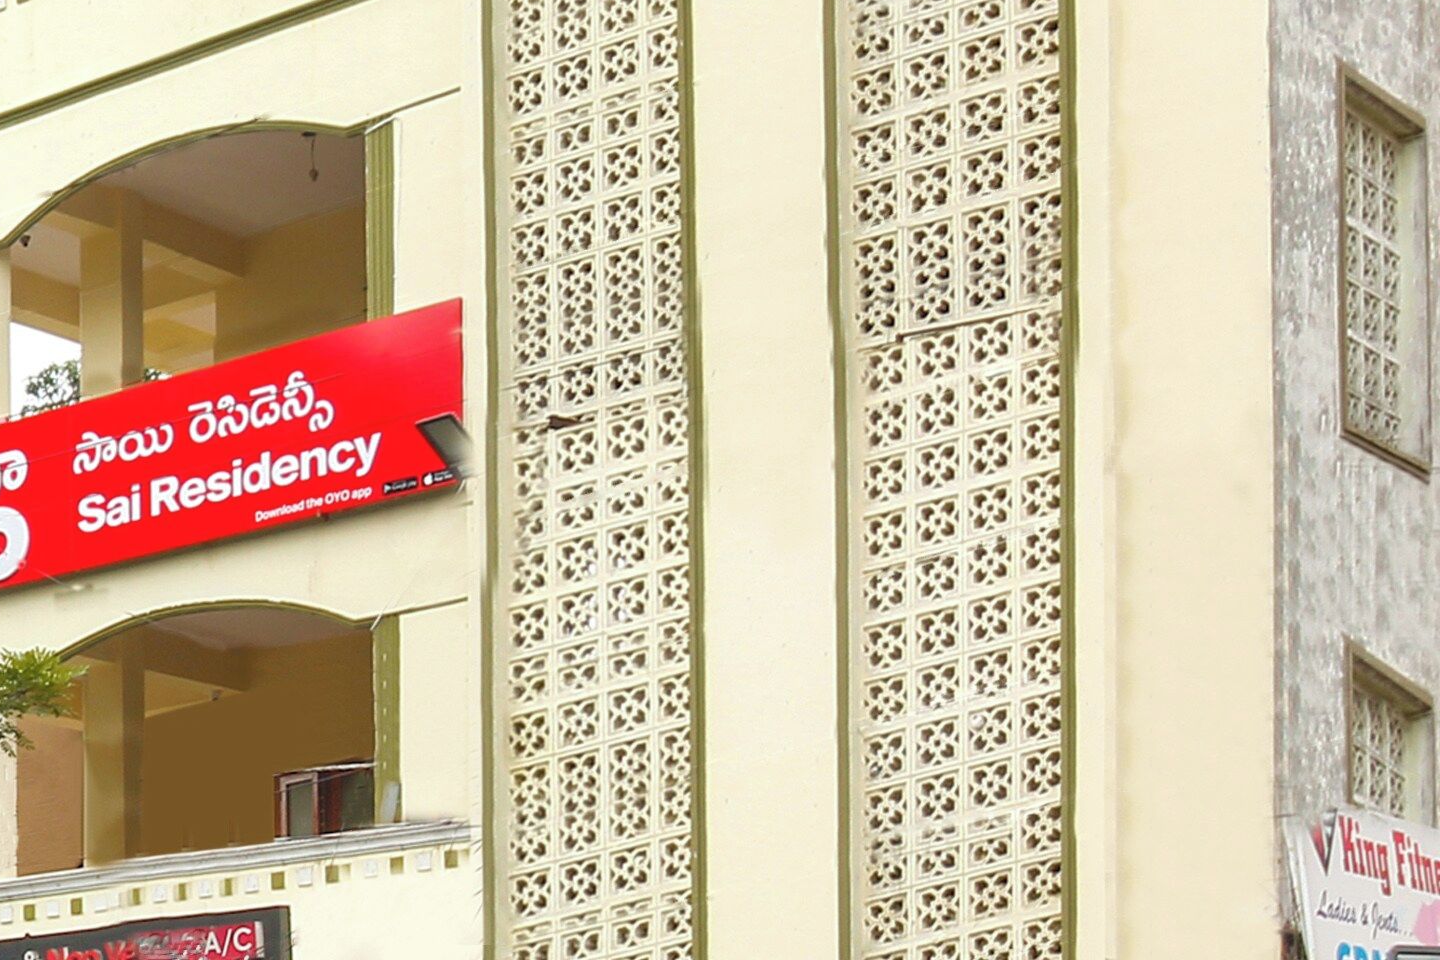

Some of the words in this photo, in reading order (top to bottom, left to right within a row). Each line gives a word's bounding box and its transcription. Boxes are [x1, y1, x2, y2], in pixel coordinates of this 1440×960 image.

[77, 484, 141, 533] Sai
[150, 432, 382, 517] Residency
[255, 501, 305, 522] Download
[306, 496, 323, 510] the
[324, 489, 350, 504] OYO
[351, 486, 372, 500] app
[1338, 815, 1392, 896] King
[1317, 889, 1357, 924] Ladies
[204, 926, 253, 957] A/C
